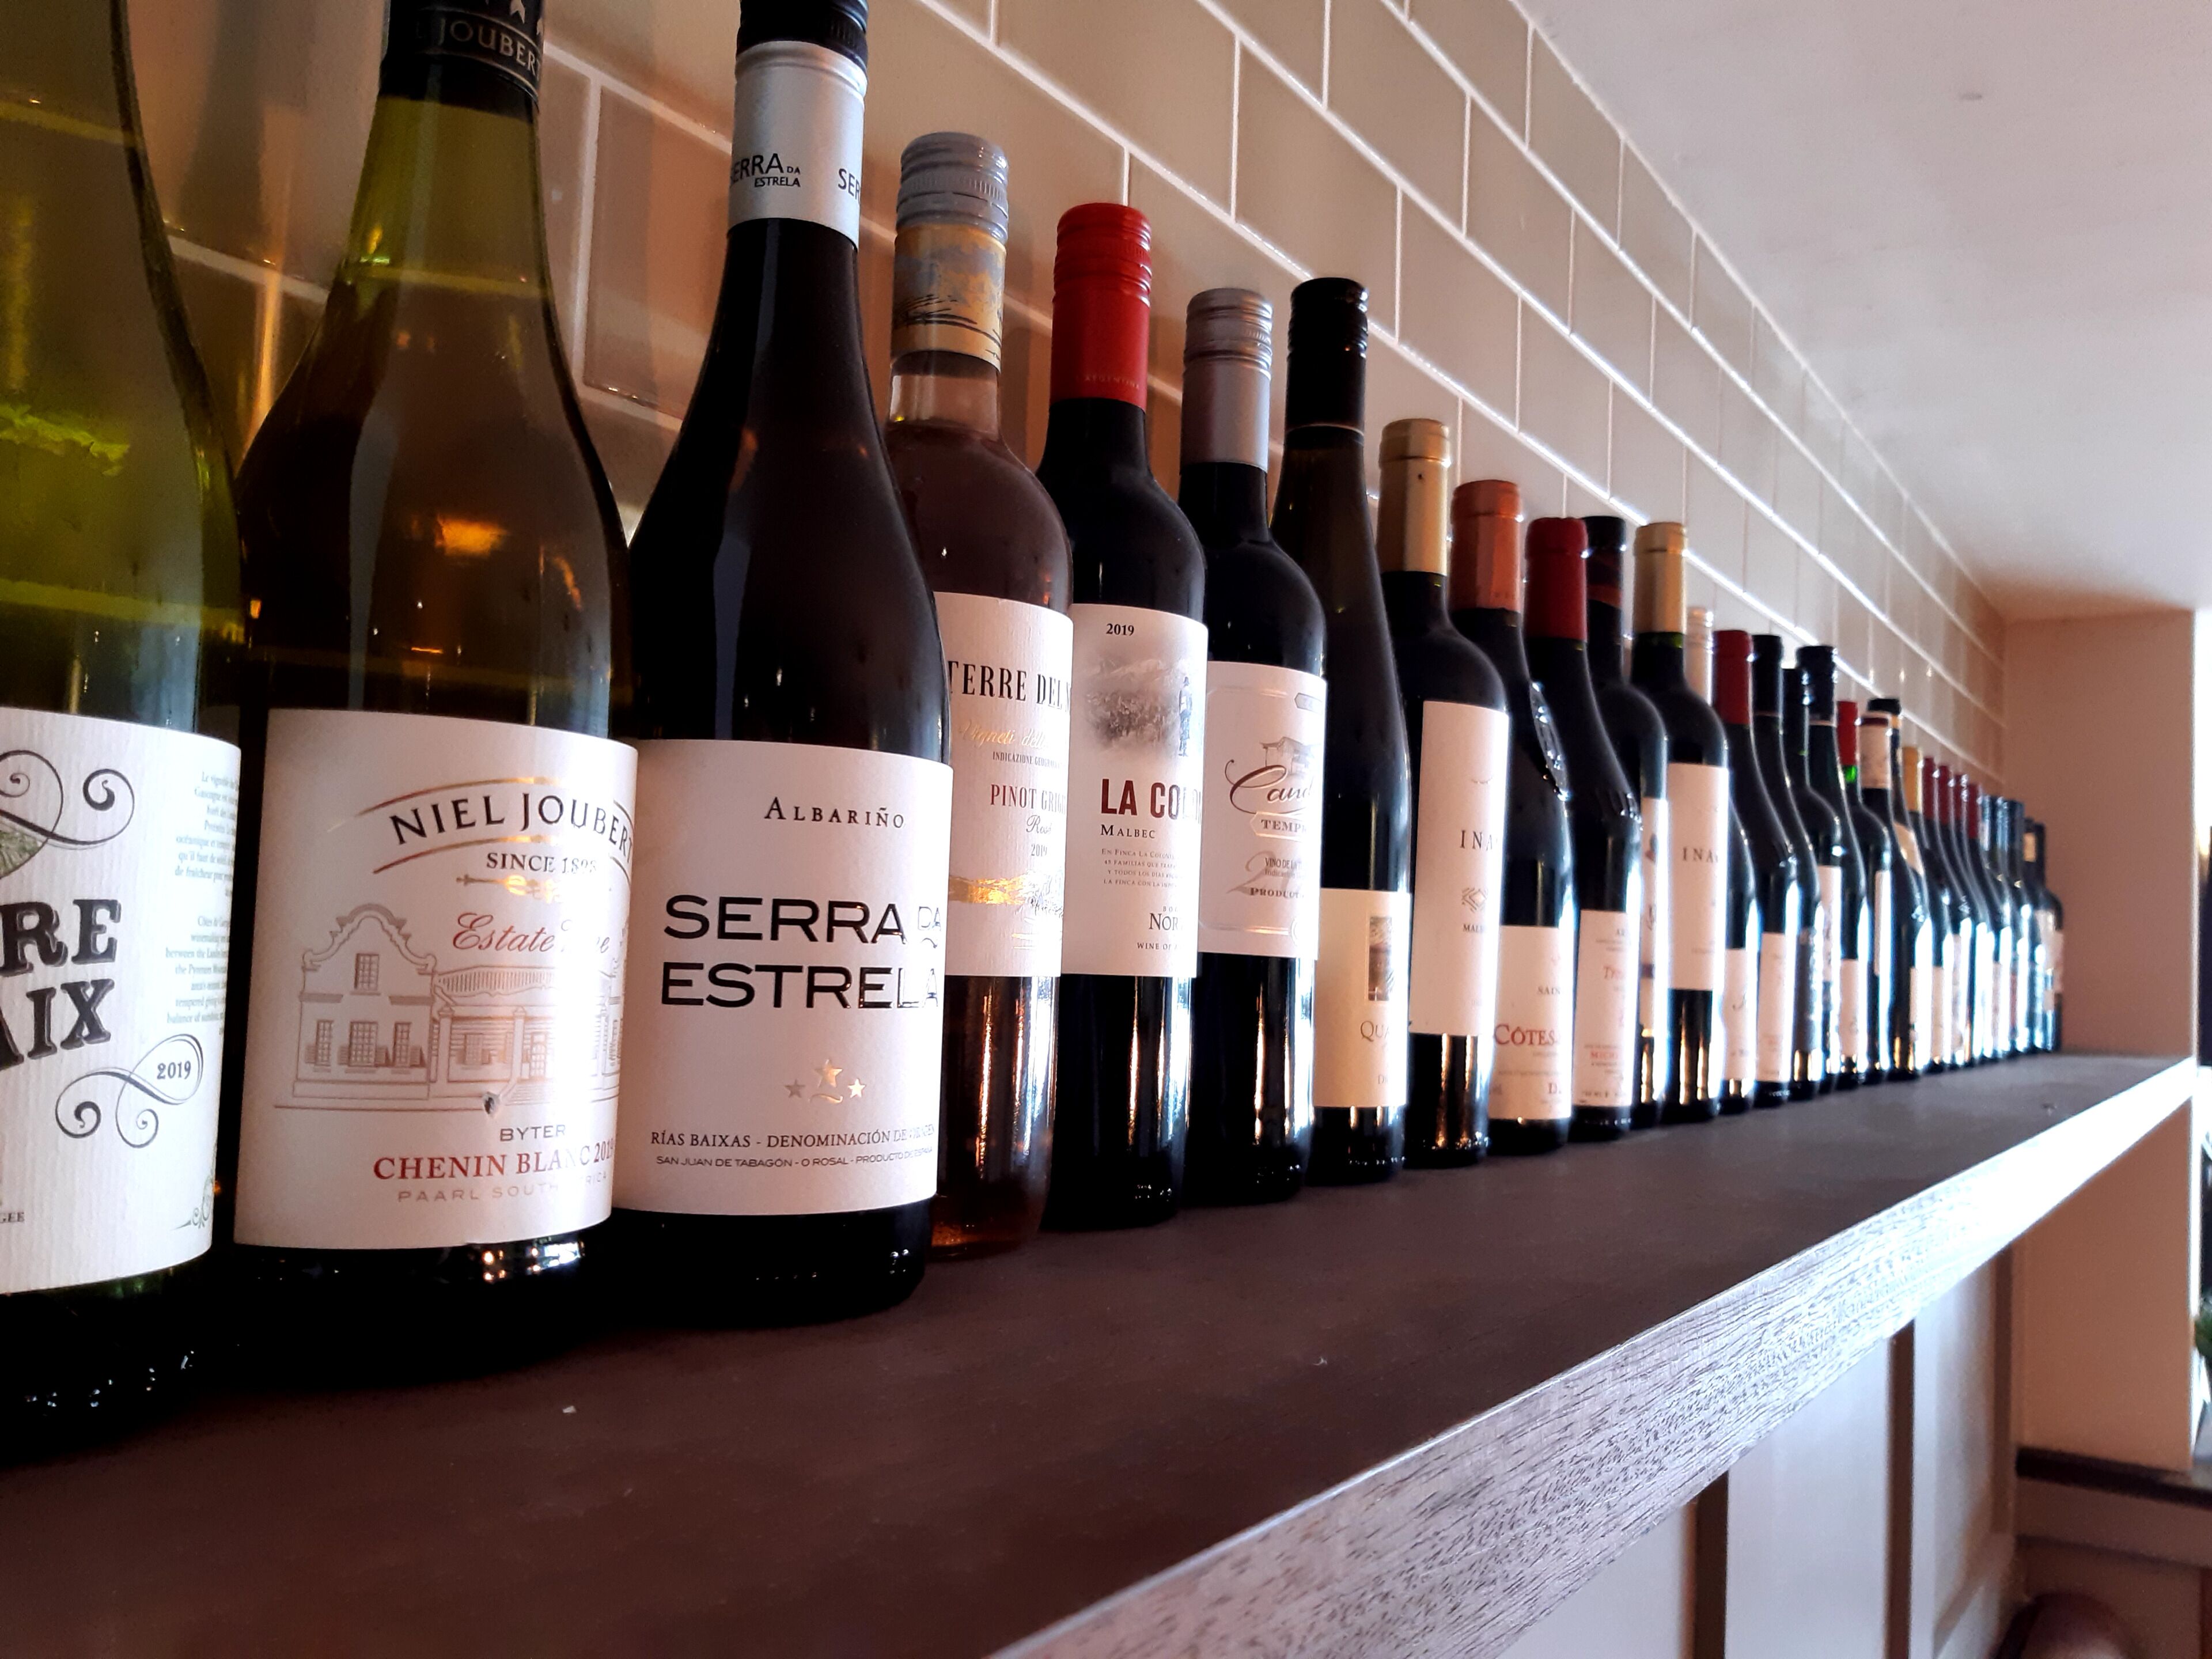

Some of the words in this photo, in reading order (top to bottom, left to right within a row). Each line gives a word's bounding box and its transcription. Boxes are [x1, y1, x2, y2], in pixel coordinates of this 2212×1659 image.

[787, 166, 801, 175] DA
[754, 176, 801, 188] ESTRELA
[1106, 623, 1134, 637] 2019
[948, 660, 1027, 702] TERRE
[993, 751, 1033, 765] INDICAZIONE
[990, 783, 1037, 809] PINOT
[1101, 778, 1138, 816] LA
[764, 797, 904, 828] ALBARIÑO
[389, 794, 506, 845] NIEL
[522, 793, 633, 863] JOUBERT
[1100, 824, 1156, 839] MALBEC
[486, 851, 555, 873] SINCE
[1115, 849, 1137, 857] FINCA
[664, 894, 907, 945] SERRA
[918, 905, 942, 932] DA
[452, 911, 555, 954] Estate
[1137, 942, 1160, 950] WINE
[661, 961, 939, 1009] ESTRELA
[0, 978, 115, 1072] IX
[1494, 1023, 1555, 1046] CÔTES
[157, 1061, 191, 1080] 2019
[500, 1123, 566, 1142] BYTER
[651, 1130, 685, 1146] RÍAS
[690, 1134, 751, 1147] BAIXAS
[767, 1128, 891, 1147] DENOMINACIÓN
[893, 1129, 907, 1142] DE
[373, 1152, 506, 1180] CHENIN
[517, 1145, 590, 1176] BLANC
[656, 1156, 679, 1165] SAN
[681, 1157, 713, 1166] JUAN
[715, 1158, 733, 1167] DE
[735, 1156, 793, 1168] TABAGÓN
[801, 1158, 810, 1167] O
[812, 1157, 849, 1166] ROSAL
[855, 1152, 903, 1164] PRODUCTO
[397, 1189, 479, 1203] PAARL
[492, 1183, 559, 1198] SOUTH
